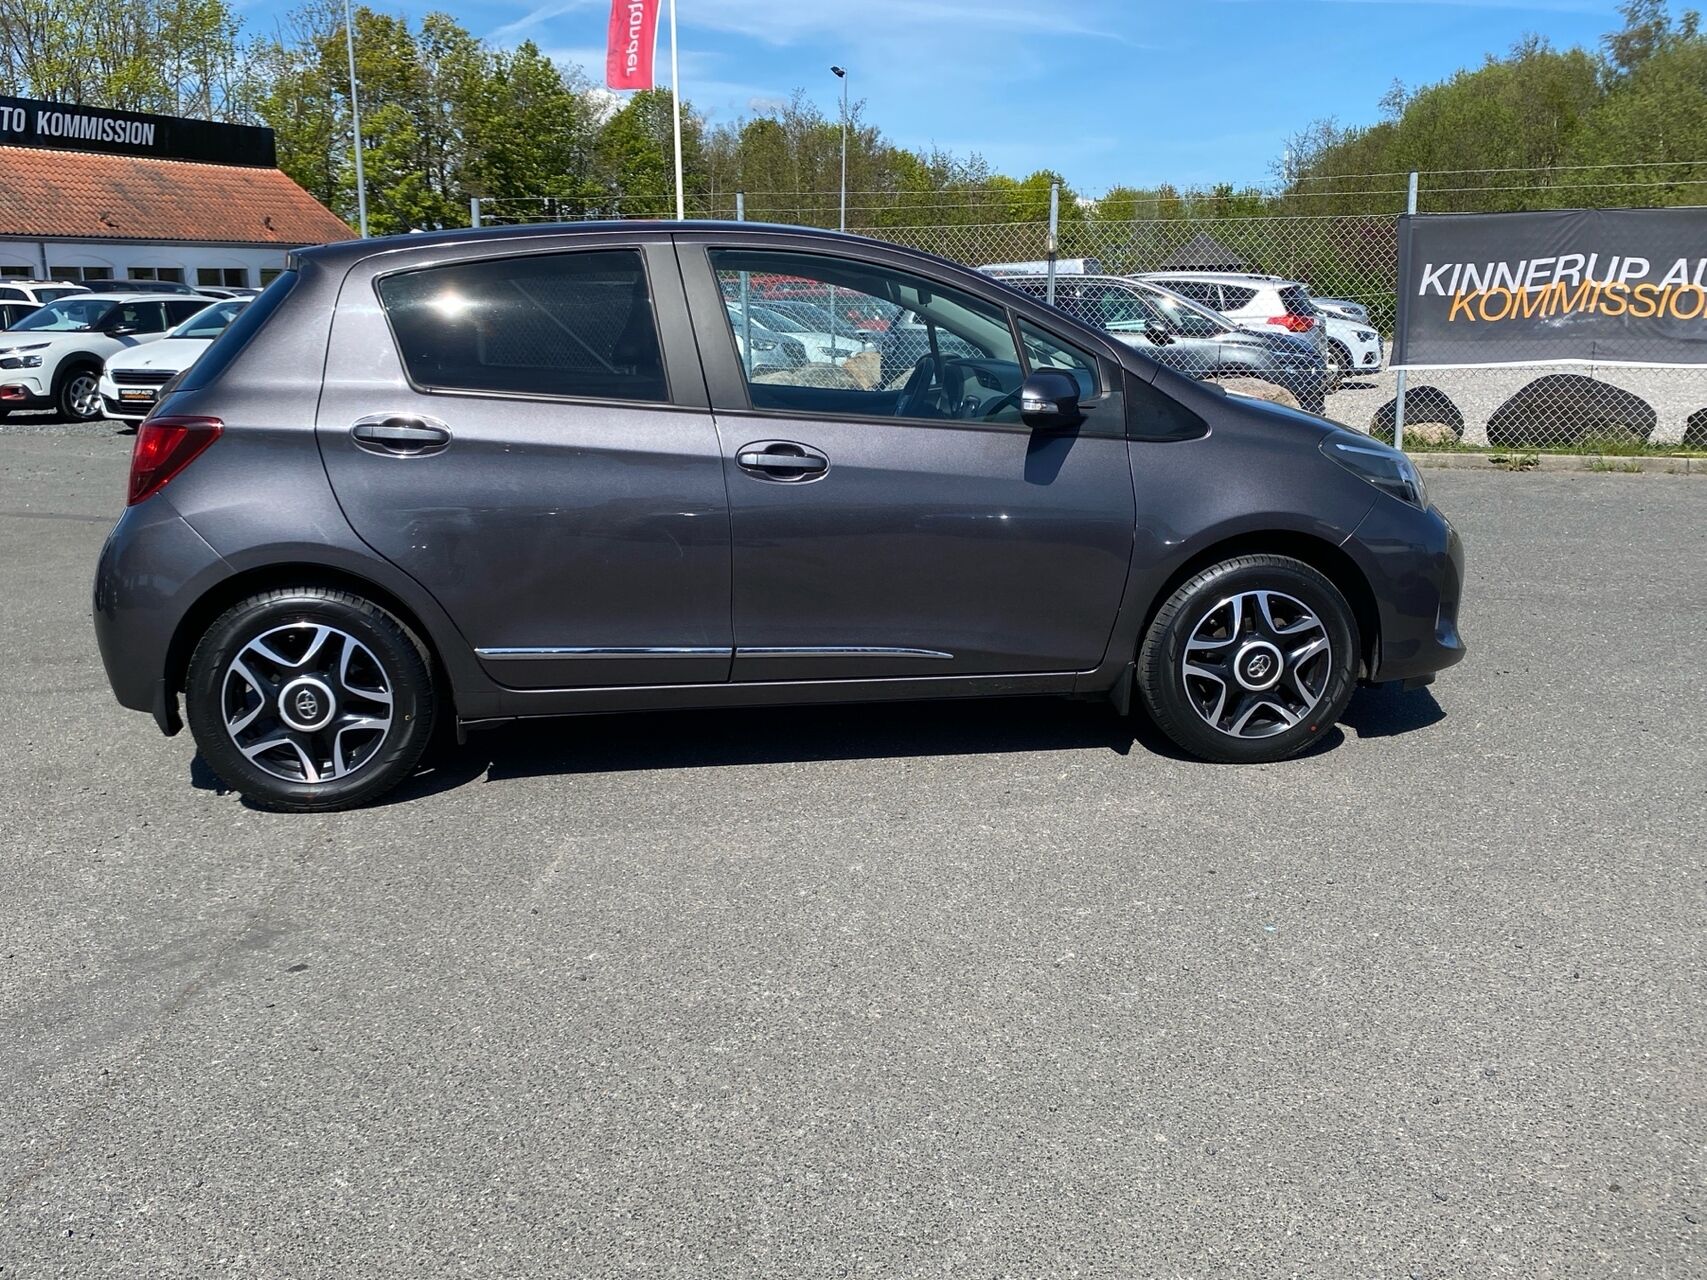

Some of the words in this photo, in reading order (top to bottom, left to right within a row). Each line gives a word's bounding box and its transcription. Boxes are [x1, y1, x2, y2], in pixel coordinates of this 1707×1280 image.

[37, 111, 155, 146] KOMMISSION
[1418, 253, 1650, 296] KINNERUP
[1449, 279, 1707, 321] KOMMISSIO
